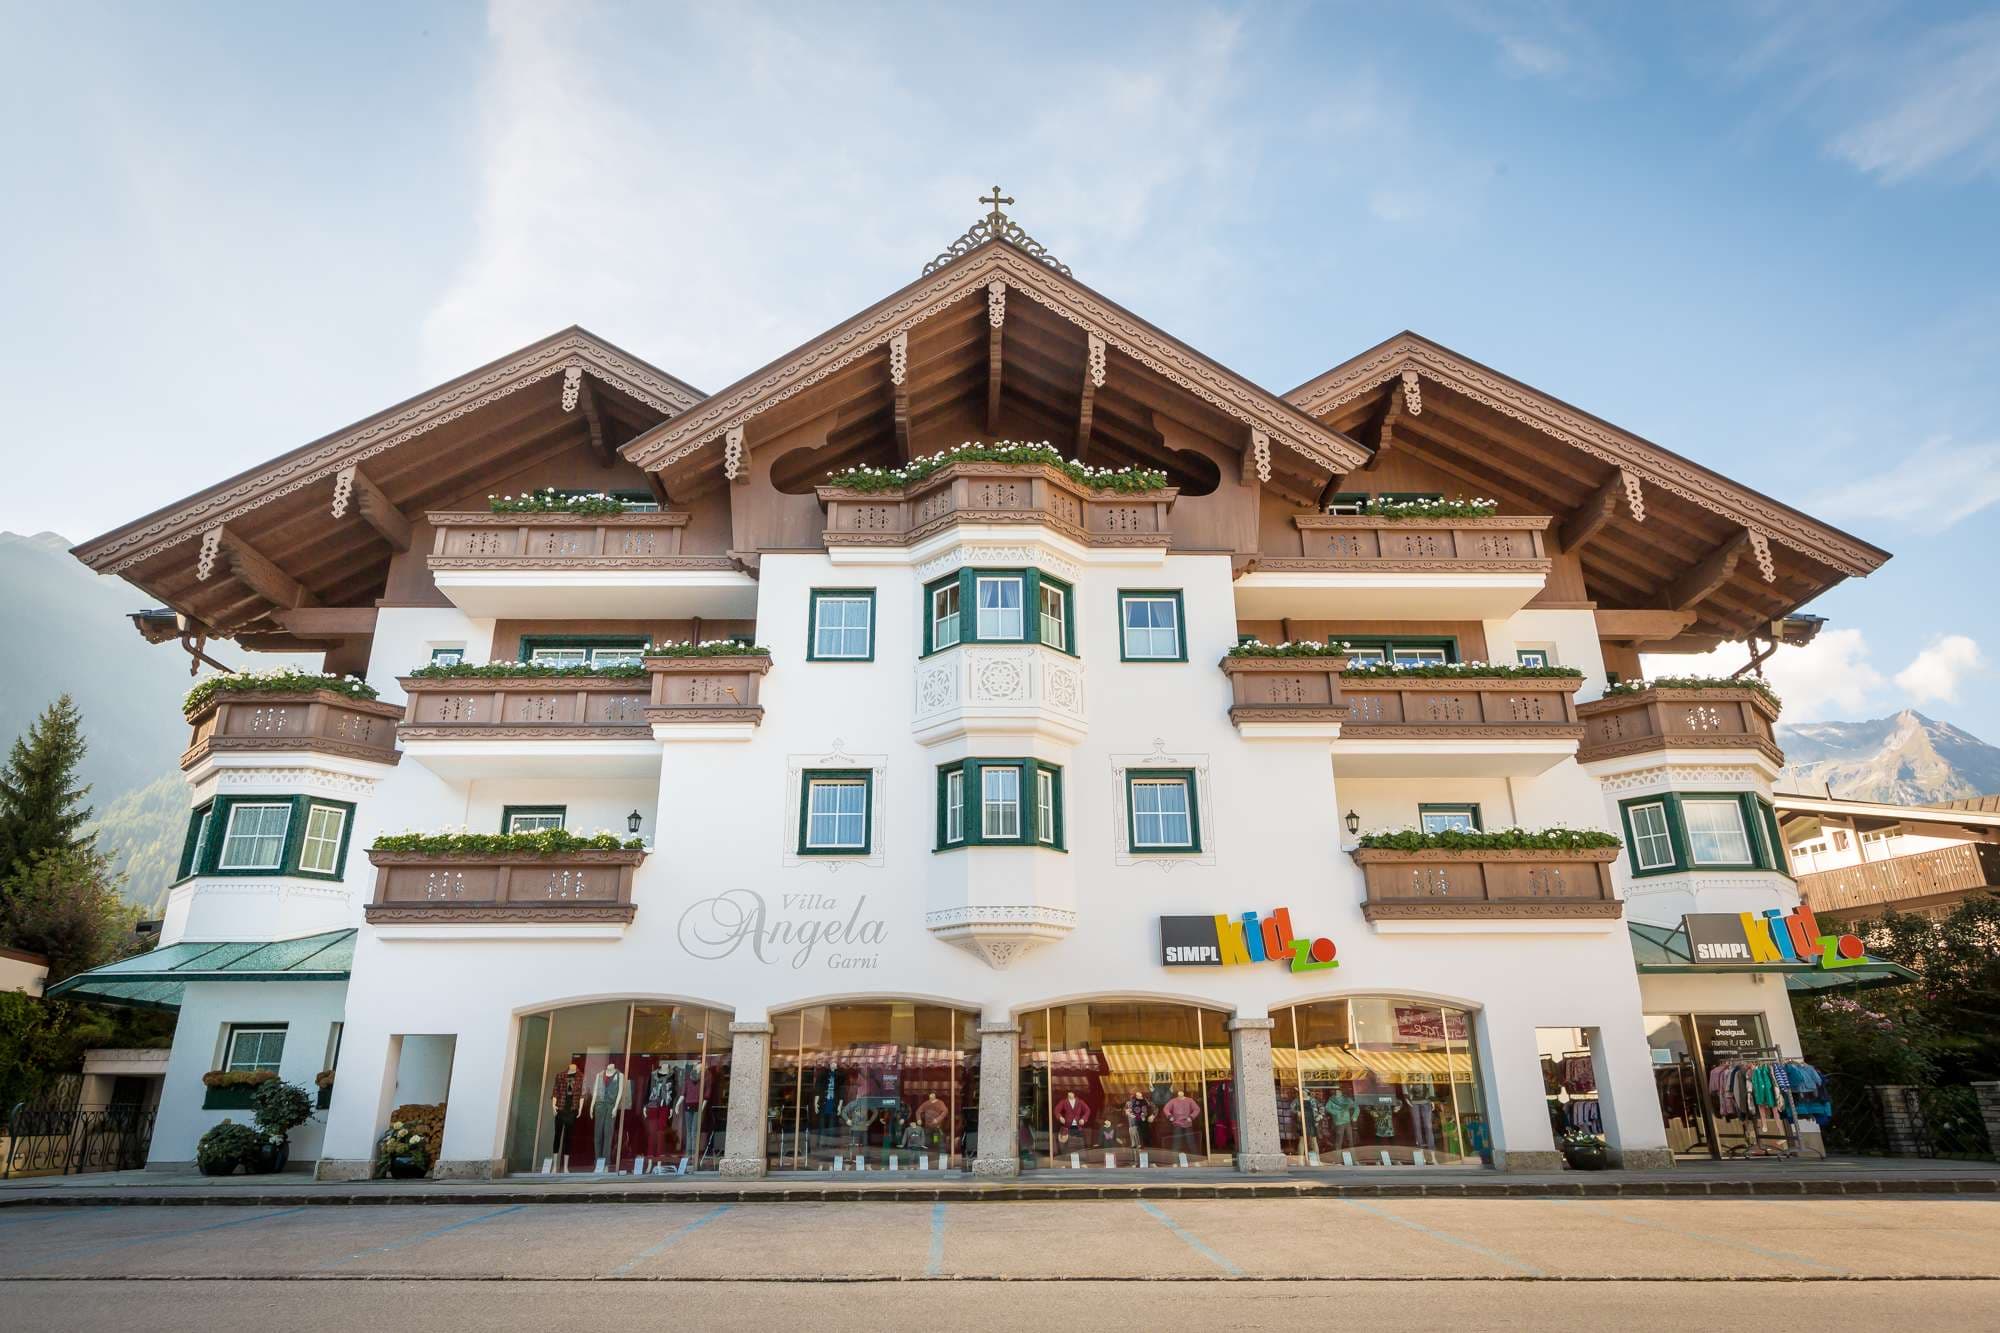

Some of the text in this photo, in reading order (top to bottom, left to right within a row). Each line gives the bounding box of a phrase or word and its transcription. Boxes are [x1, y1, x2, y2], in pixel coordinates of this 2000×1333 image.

[782, 893, 838, 911] Villa
[677, 888, 889, 970] Angela
[1166, 946, 1219, 962] SIMPL
[1697, 943, 1750, 959] SIMPL
[827, 953, 880, 969] Garni
